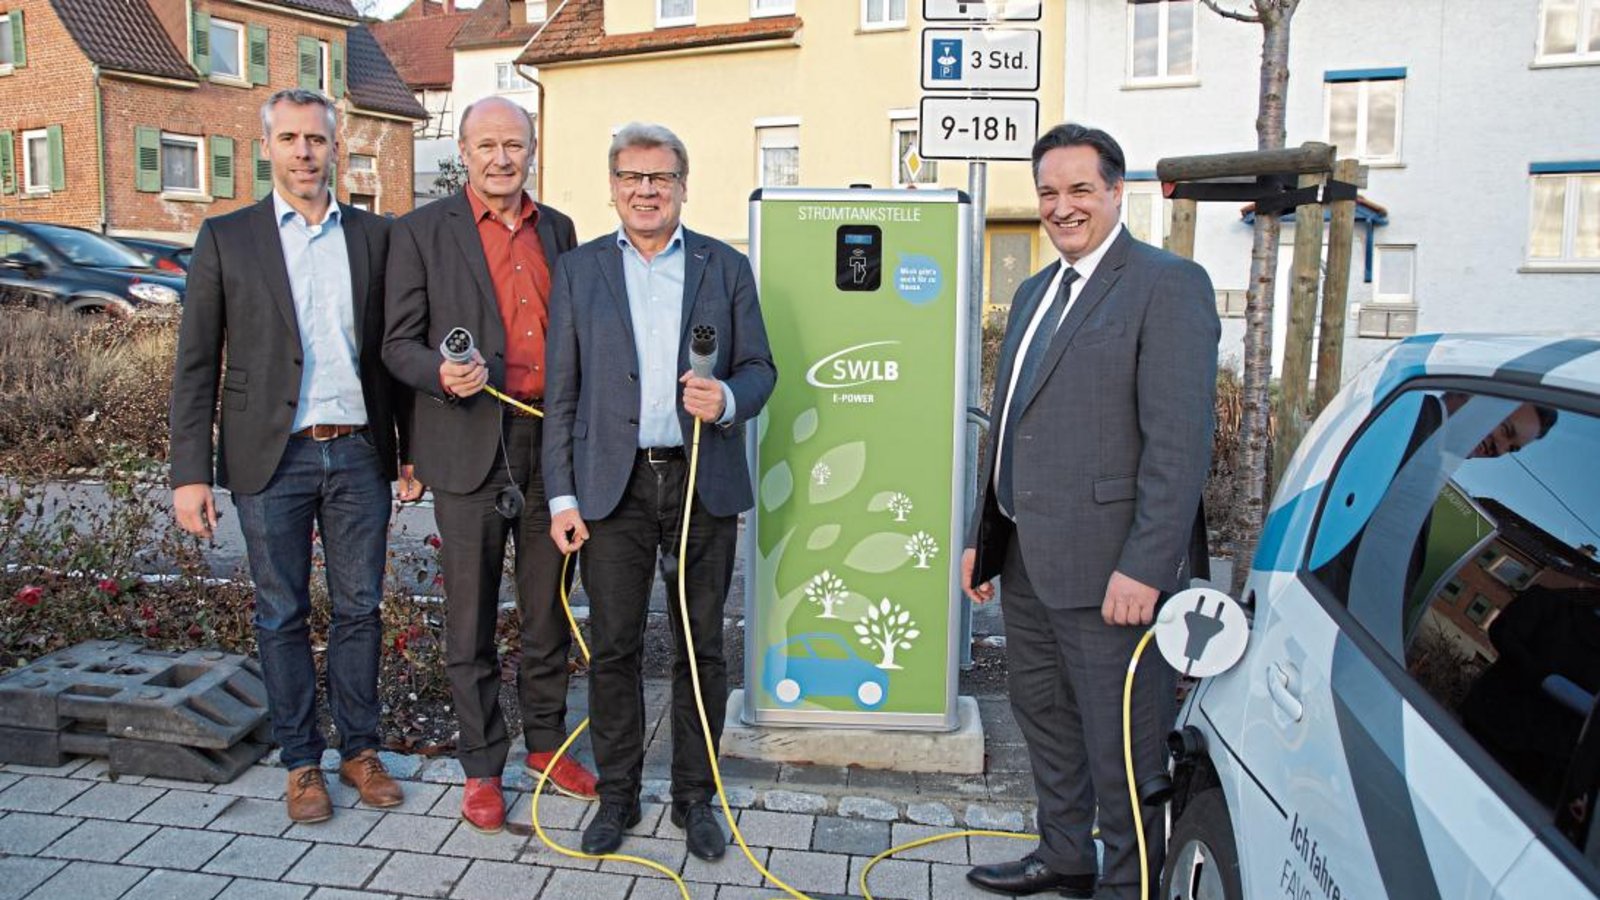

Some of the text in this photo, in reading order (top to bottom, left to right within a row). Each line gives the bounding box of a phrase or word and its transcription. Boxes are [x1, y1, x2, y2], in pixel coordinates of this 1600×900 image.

[971, 51, 1028, 69] 3 Std.
[941, 116, 1017, 141] 9-18 h
[798, 206, 921, 222] STROMTANKSTELLE
[832, 360, 899, 381] SWLB
[833, 394, 874, 404] E-POWER
[1290, 811, 1310, 863] Ich
